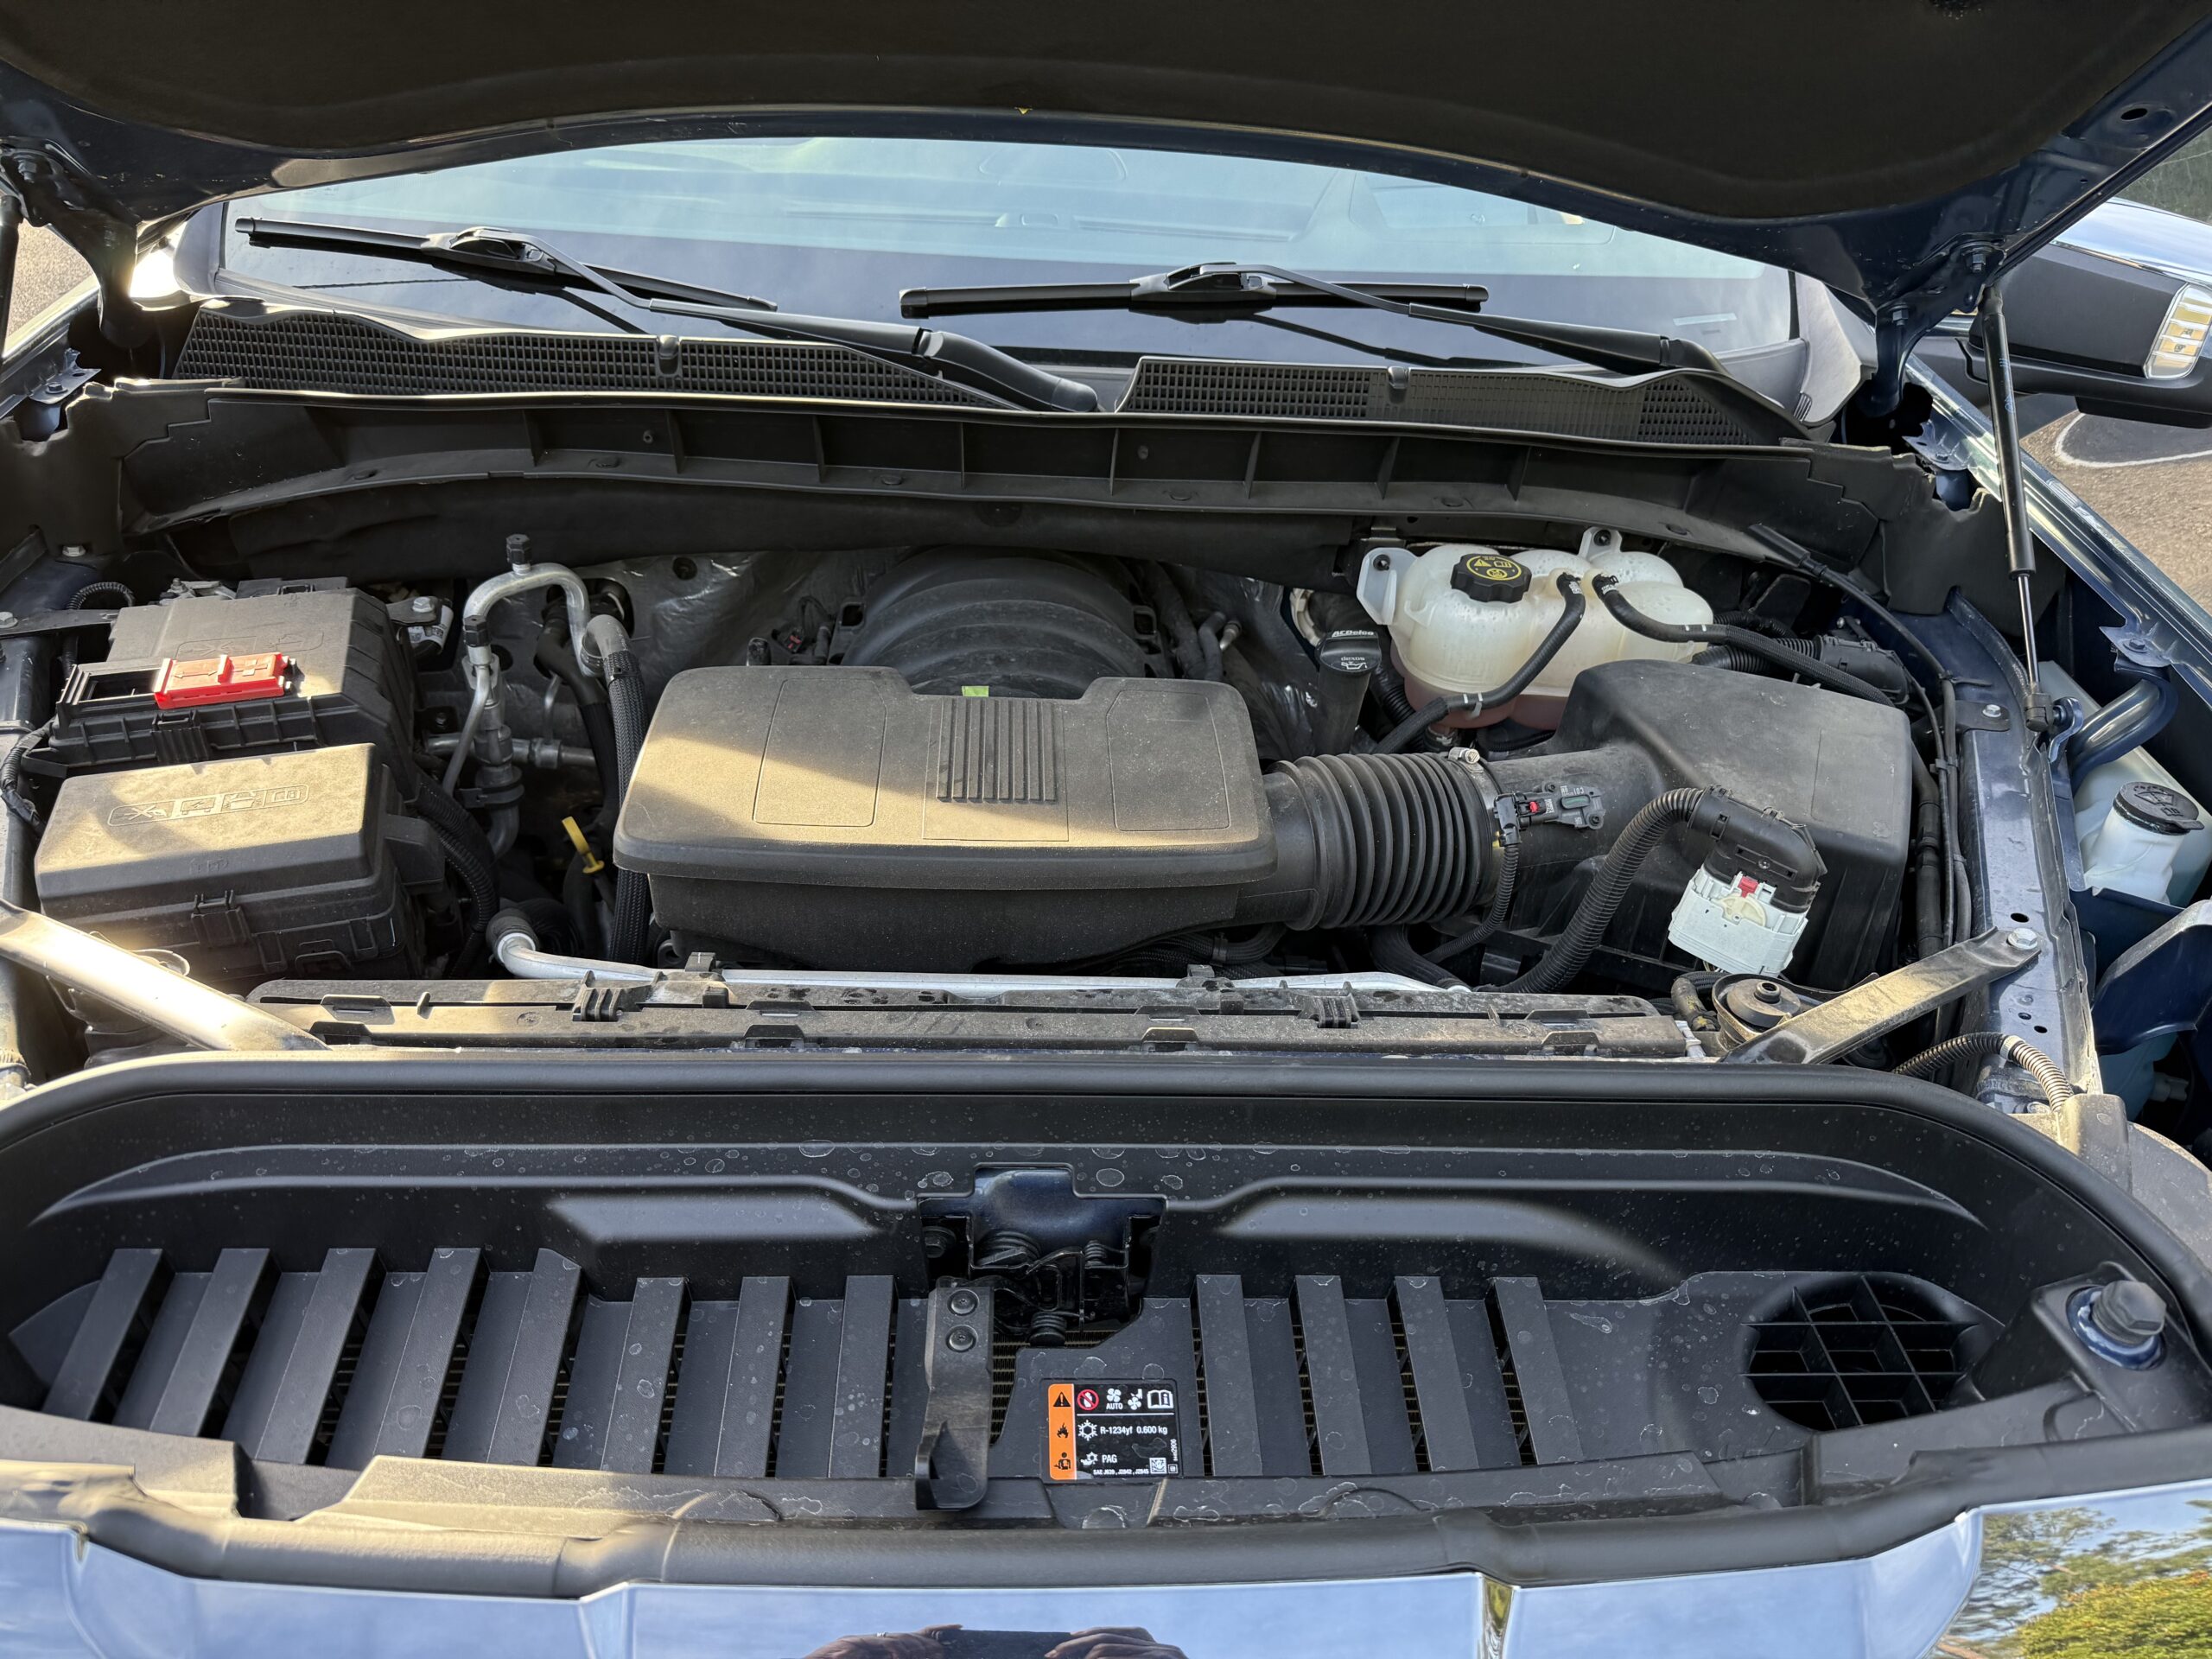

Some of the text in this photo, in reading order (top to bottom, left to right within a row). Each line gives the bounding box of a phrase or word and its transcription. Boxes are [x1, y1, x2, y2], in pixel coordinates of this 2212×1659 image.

[1100, 1426, 1133, 1435] R-1234yf
[1158, 1426, 1168, 1435] kg
[1102, 1454, 1118, 1463] PAG
